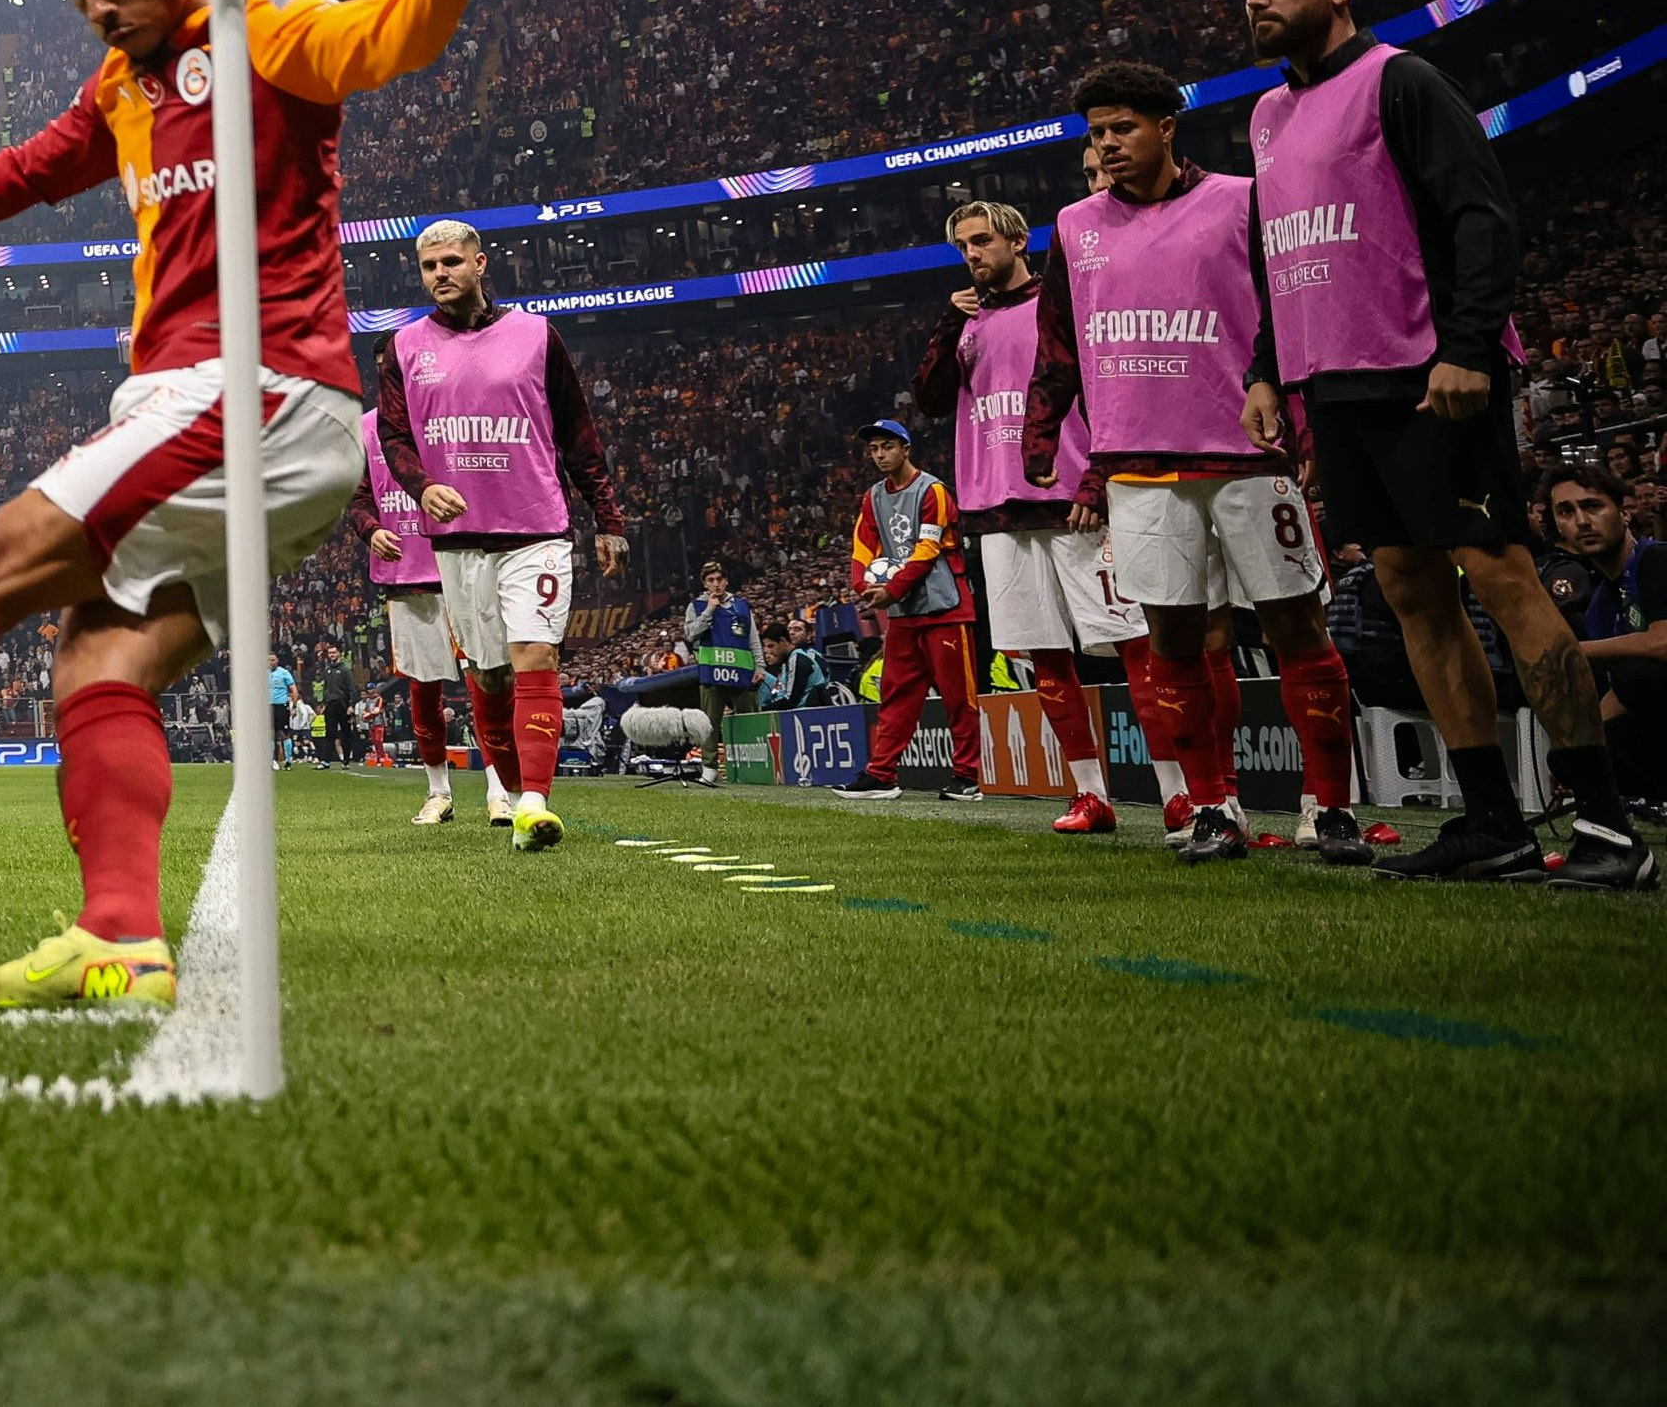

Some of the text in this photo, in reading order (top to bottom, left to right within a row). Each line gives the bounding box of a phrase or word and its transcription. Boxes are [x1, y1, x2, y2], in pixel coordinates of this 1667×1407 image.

[885, 122, 1063, 168] UEFA CHAMPIONS LEAGUE
[139, 159, 215, 206] SOCAR
[559, 201, 603, 216] PS5
[82, 245, 120, 257] UEFA
[527, 293, 615, 313] CHAMPIONS
[617, 286, 674, 305] LEAGUE
[1085, 310, 1219, 347] #FOOTBALL
[1119, 359, 1188, 373] RESPECT
[424, 416, 530, 445] #FOOTBALL
[457, 457, 509, 468] RESPECT
[1272, 503, 1304, 549] 8
[536, 573, 559, 607] 9
[715, 650, 736, 664] HB
[713, 668, 739, 683] 004
[810, 723, 853, 768] PS5
